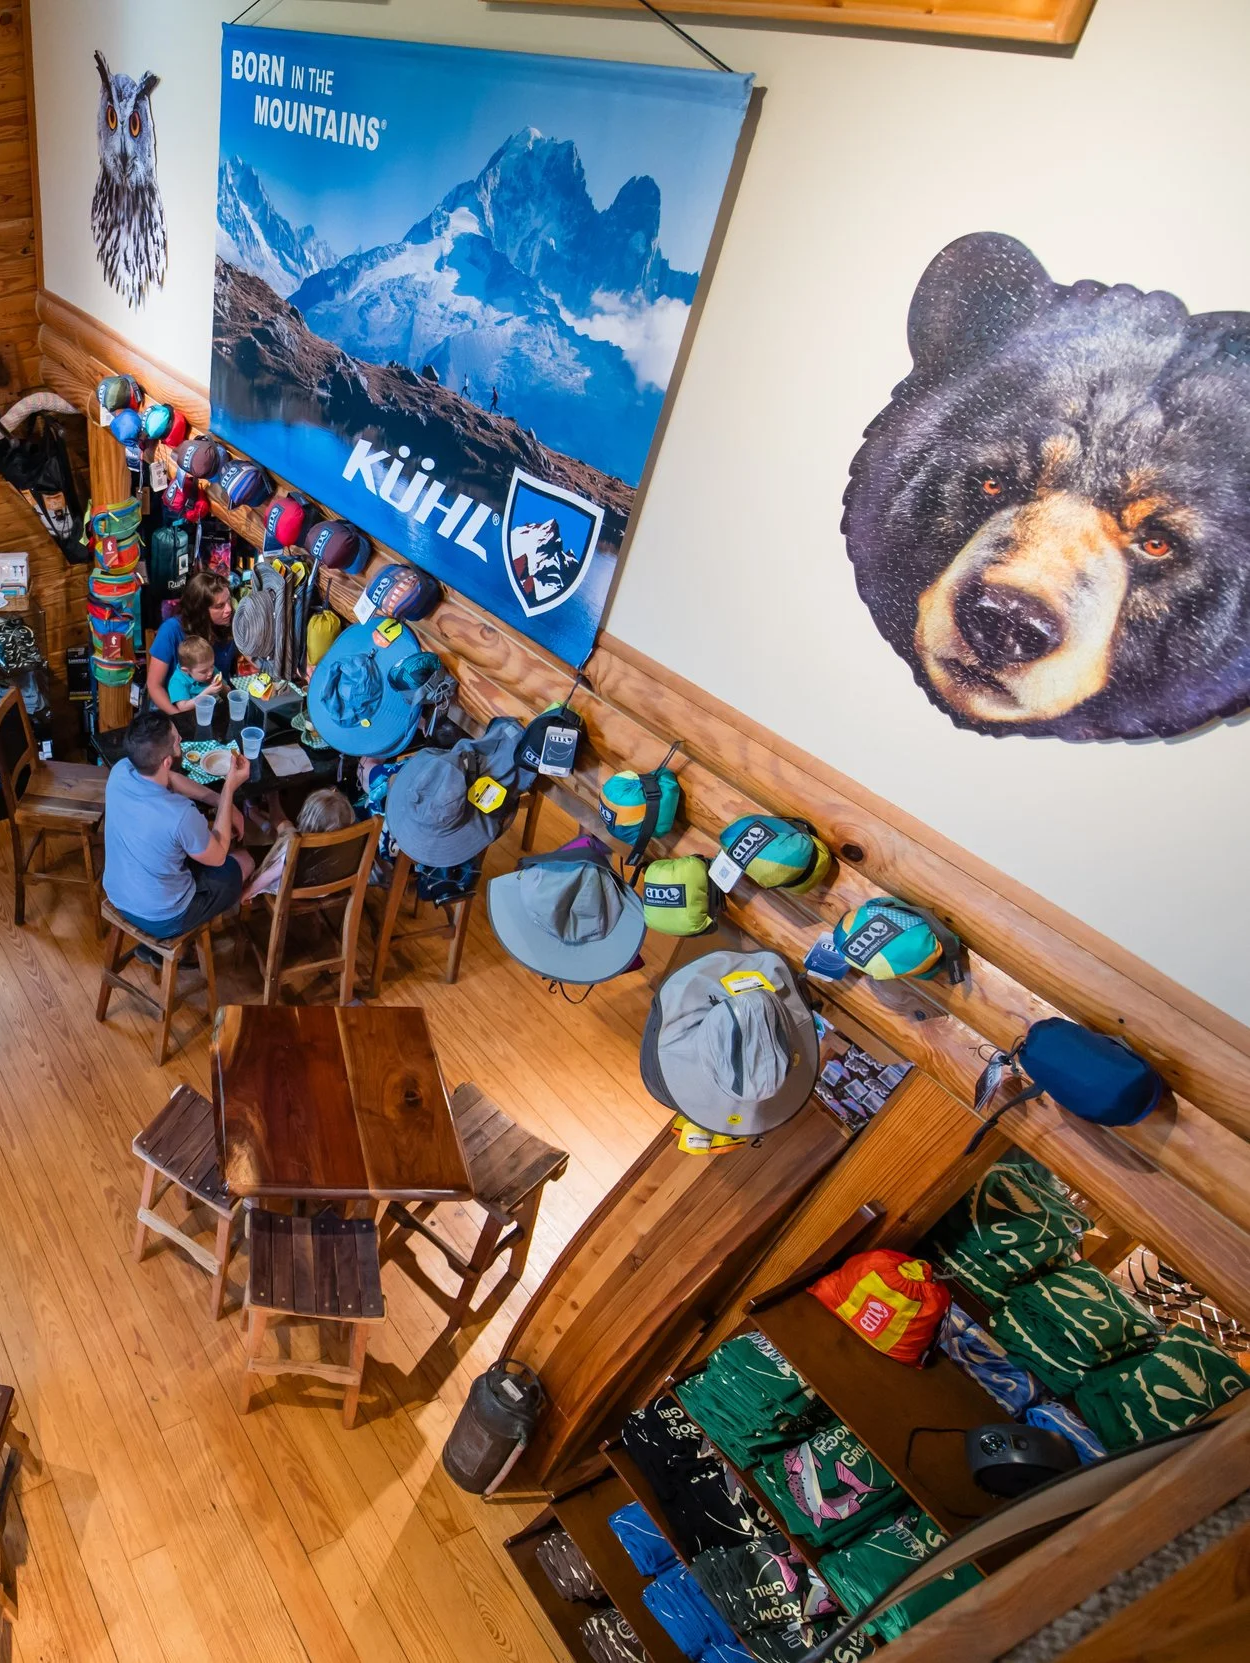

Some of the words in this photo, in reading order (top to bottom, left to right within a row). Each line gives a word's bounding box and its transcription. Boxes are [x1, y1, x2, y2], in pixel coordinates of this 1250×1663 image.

[232, 50, 285, 87] BORN
[291, 65, 304, 90] IN
[309, 68, 334, 96] THE
[733, 832, 759, 859] eno
[646, 887, 673, 900] eno
[848, 926, 881, 956] eno
[746, 1581, 786, 1600] GRILL
[758, 1600, 802, 1621] ROOM
[770, 1597, 779, 1606] &
